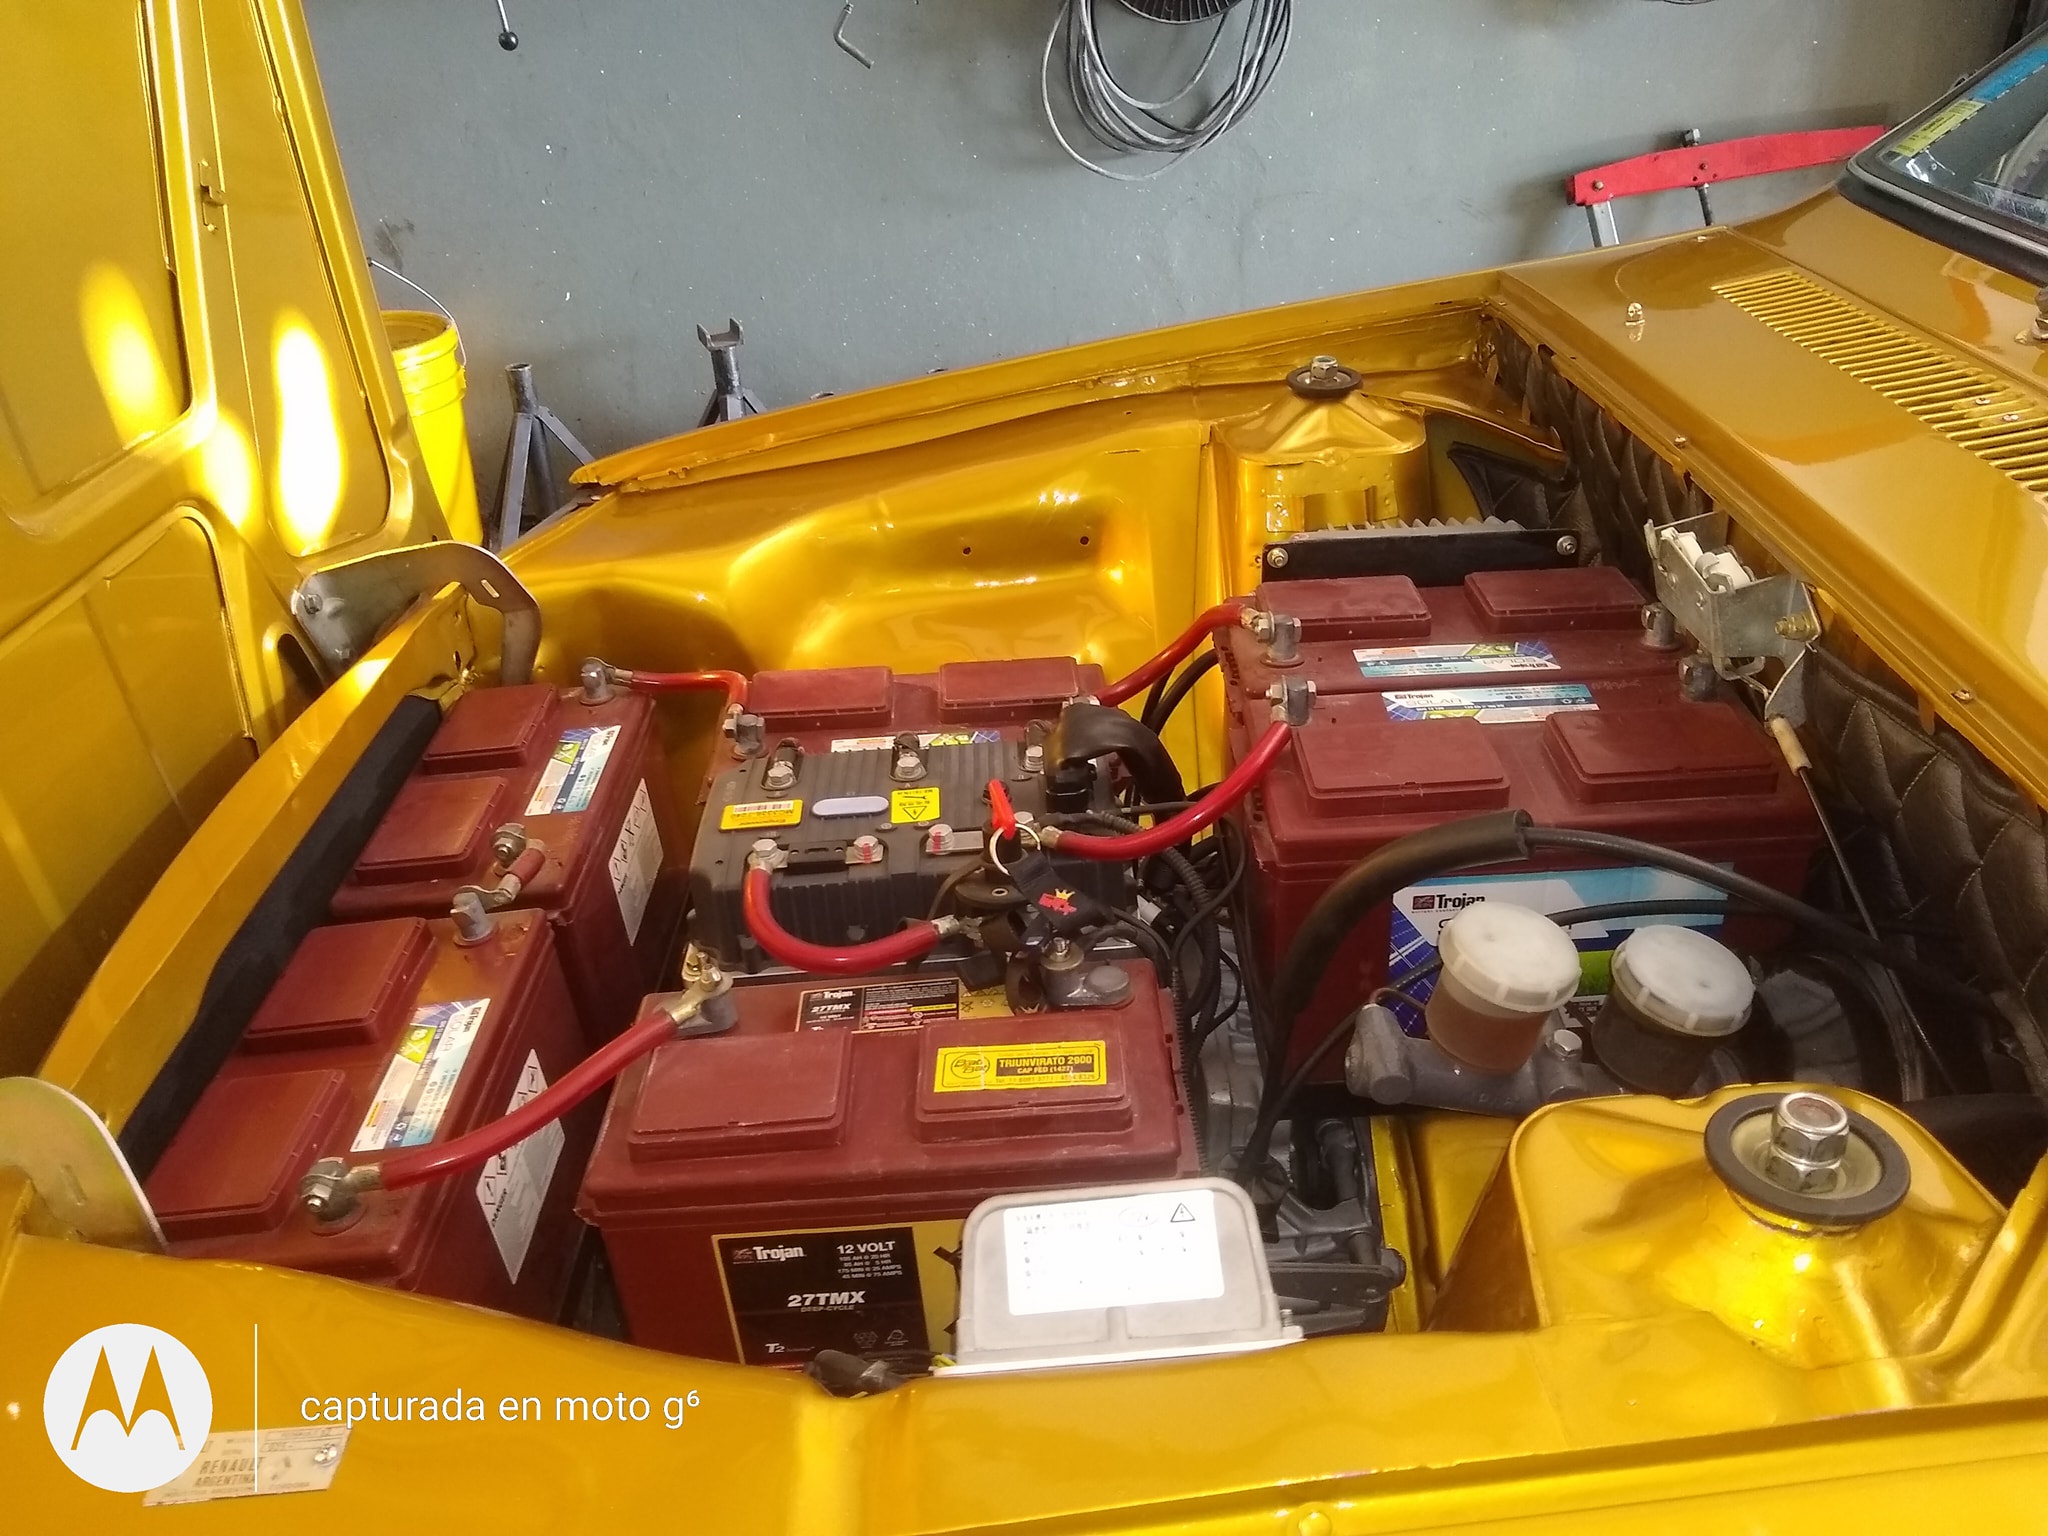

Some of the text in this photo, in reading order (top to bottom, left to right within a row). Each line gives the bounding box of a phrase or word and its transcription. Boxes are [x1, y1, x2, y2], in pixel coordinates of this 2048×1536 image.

[811, 1003, 852, 1013] 27TMX
[999, 1057, 1066, 1068] TRIUNVIRATO
[1033, 1066, 1048, 1074] FED
[753, 1245, 804, 1262] Trojan
[836, 1241, 896, 1254] 12 VOLT
[787, 1291, 866, 1308] 27TMX
